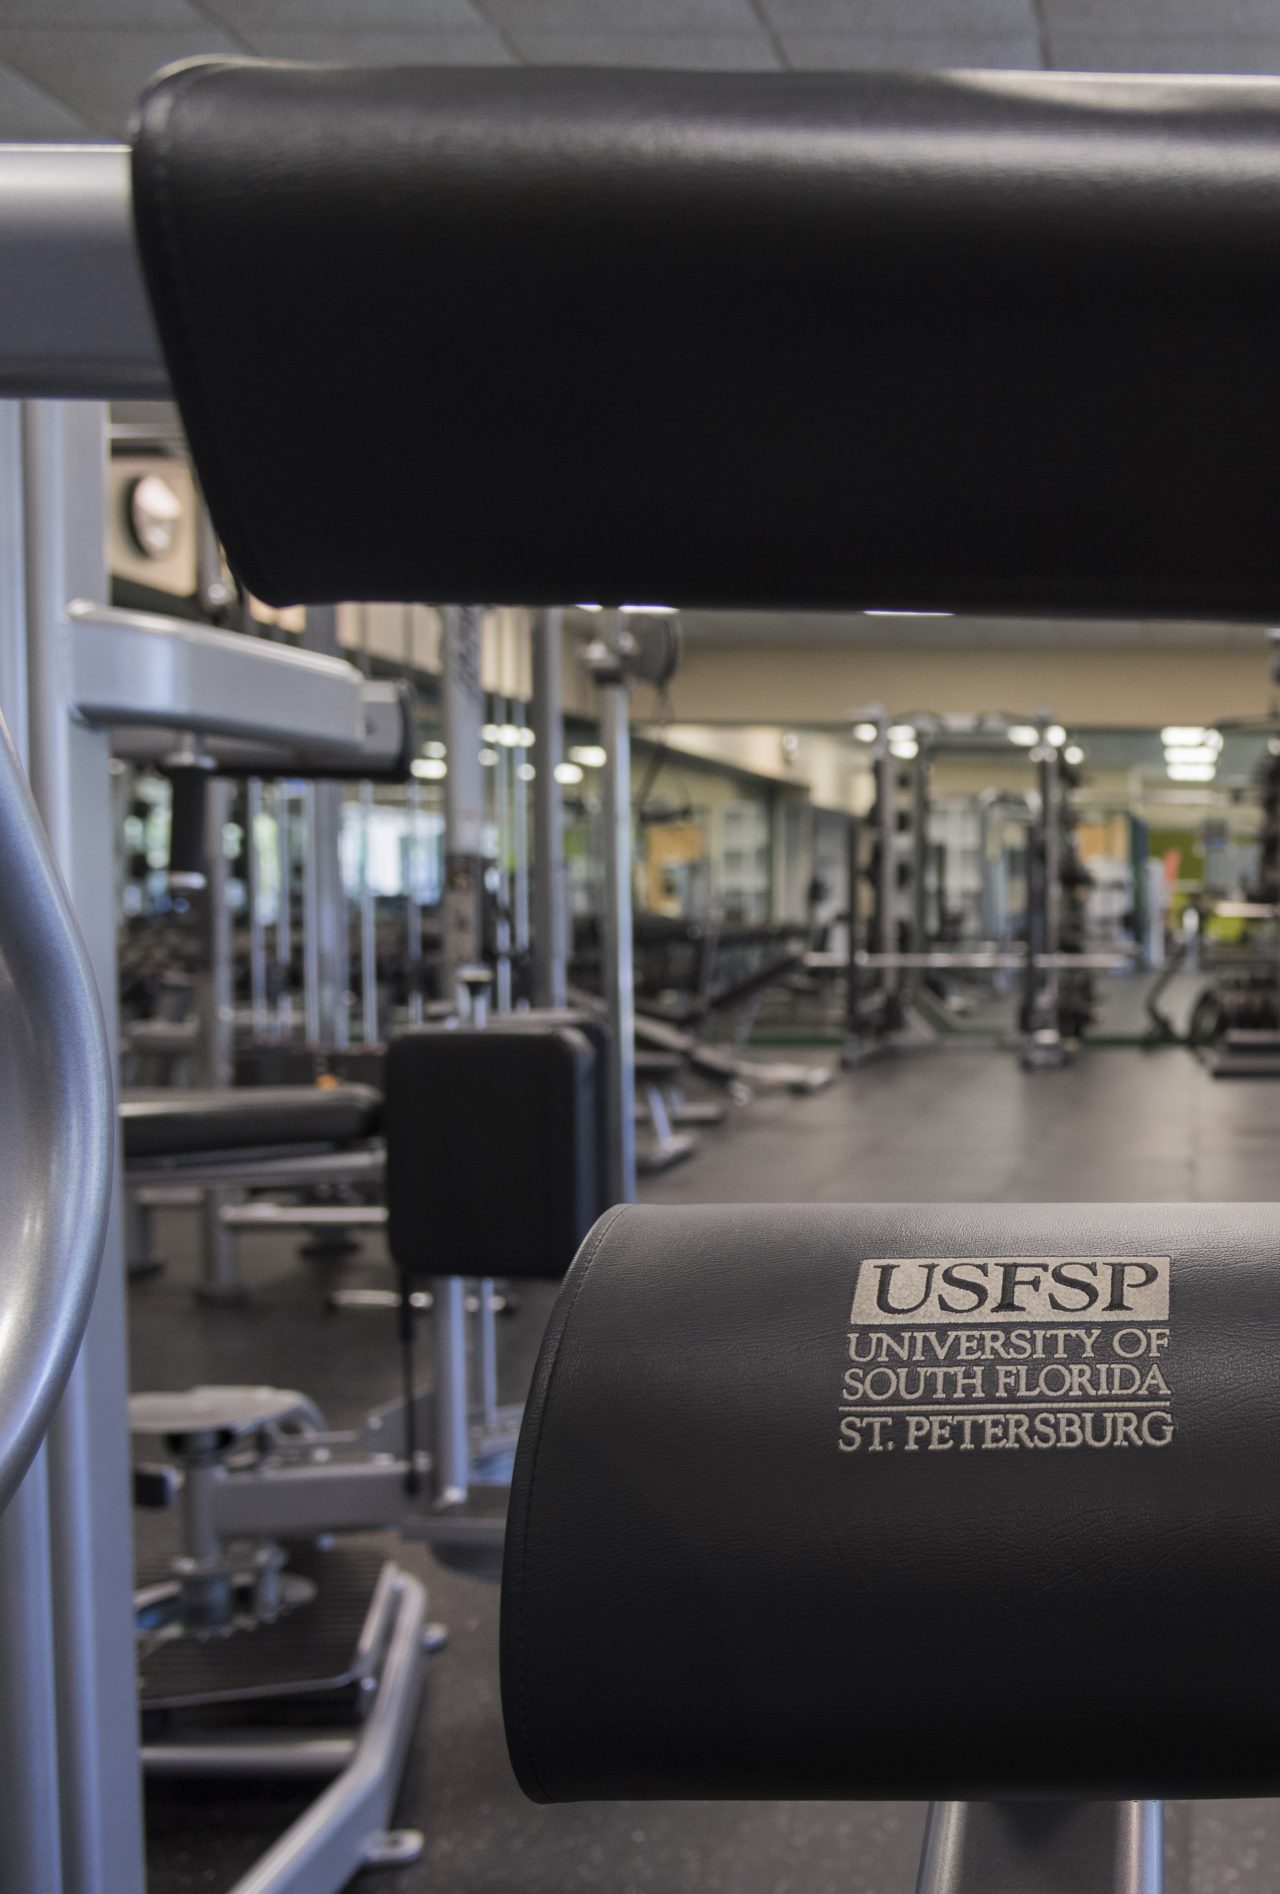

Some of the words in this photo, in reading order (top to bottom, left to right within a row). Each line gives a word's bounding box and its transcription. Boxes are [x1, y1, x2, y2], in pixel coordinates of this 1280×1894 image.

[873, 1261, 1159, 1314] USFSP
[847, 1329, 1101, 1362] UNIVERSITY
[1112, 1328, 1171, 1358] OF
[843, 1366, 985, 1400] SOUTH
[996, 1363, 1172, 1397] FLORIDA
[838, 1415, 895, 1452] ST.
[905, 1410, 1175, 1450] PETERSBURG
